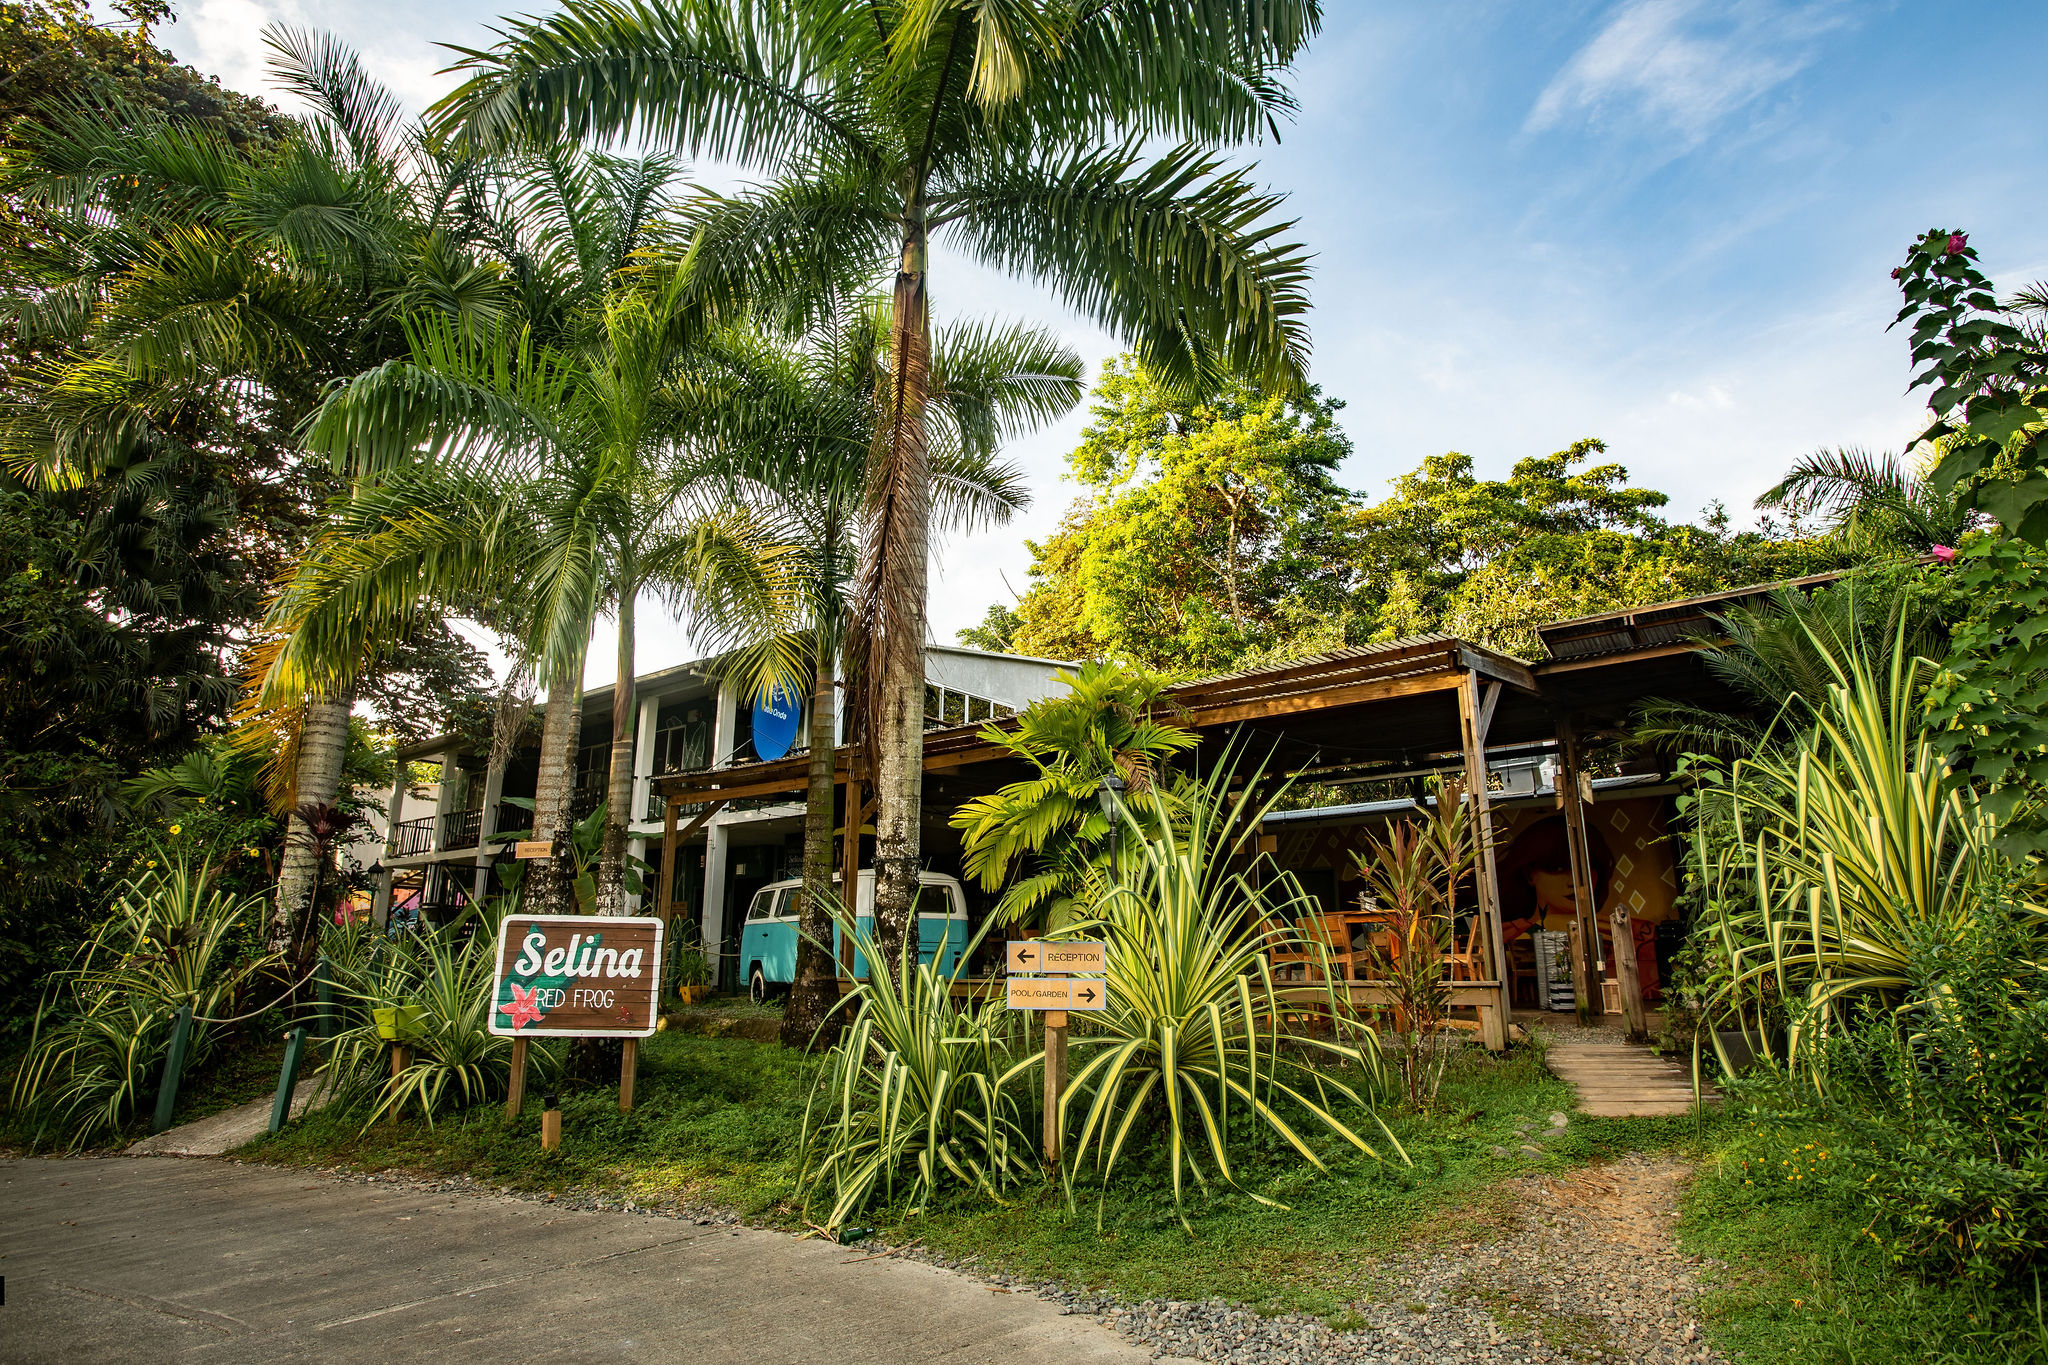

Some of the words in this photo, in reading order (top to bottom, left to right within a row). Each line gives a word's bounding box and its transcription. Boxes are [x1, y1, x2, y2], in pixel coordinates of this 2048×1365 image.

[773, 708, 787, 720] Onda
[514, 932, 644, 978] Selina
[1047, 953, 1100, 962] RECEPTION
[535, 988, 566, 1008] RED
[573, 989, 615, 1009] FROG
[1010, 989, 1068, 998] POOL/GARDEN
